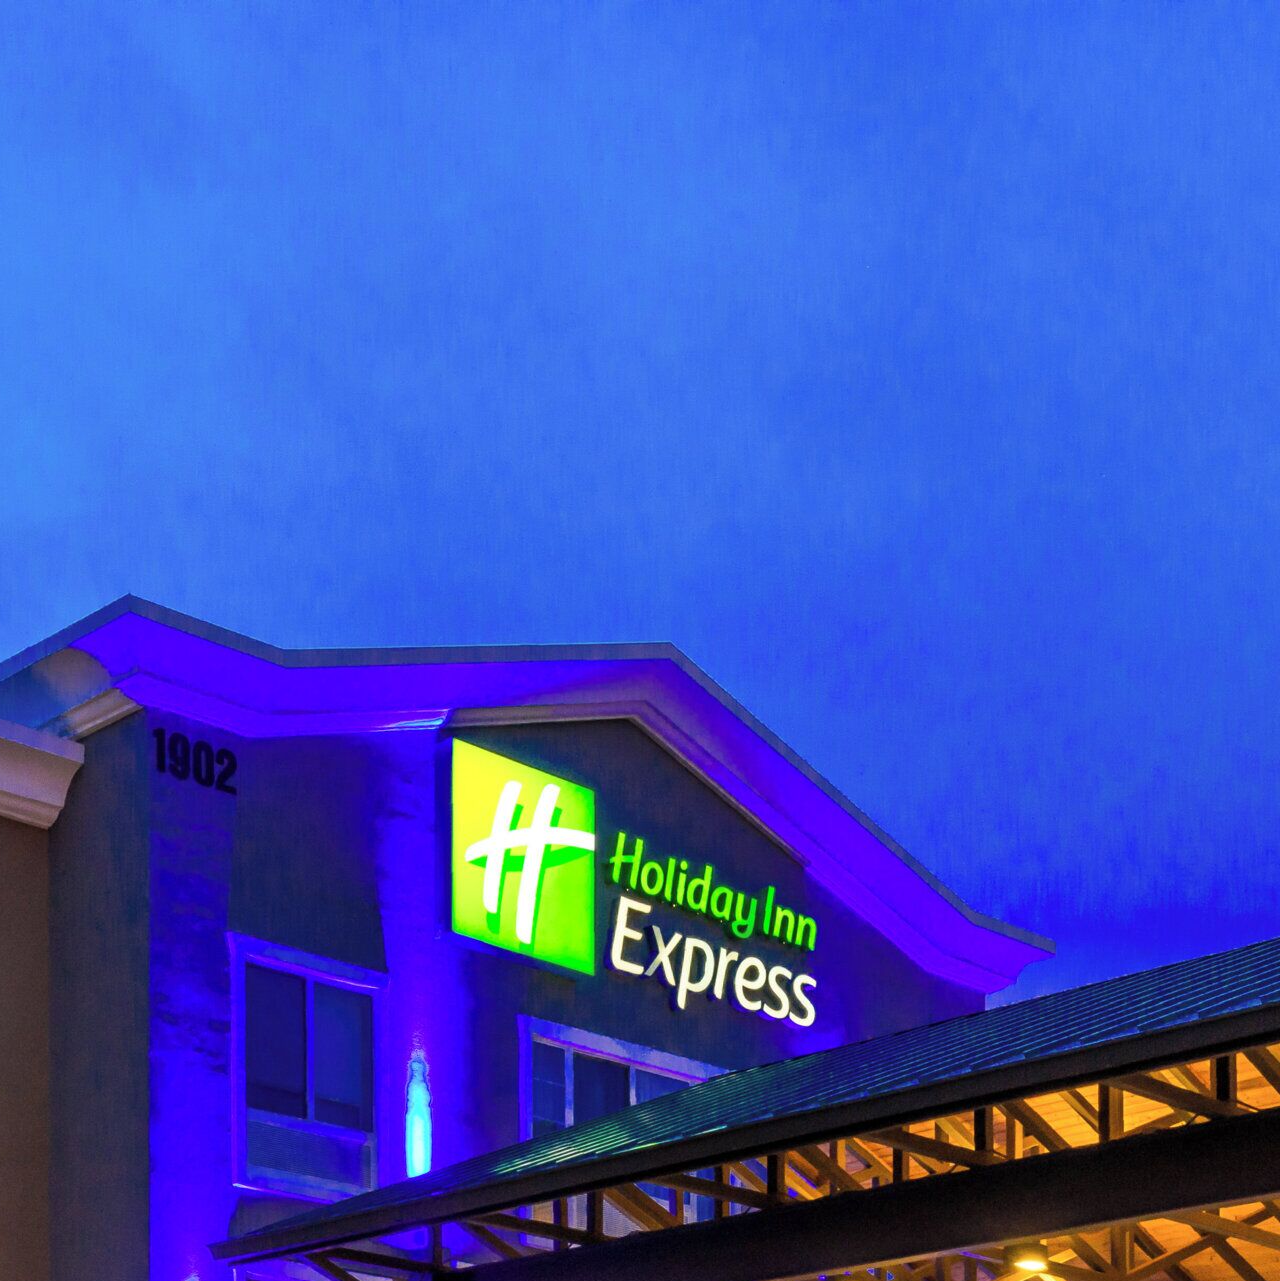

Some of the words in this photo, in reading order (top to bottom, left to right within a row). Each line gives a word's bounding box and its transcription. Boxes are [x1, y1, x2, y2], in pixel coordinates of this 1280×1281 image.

[152, 727, 238, 796] 1902
[609, 832, 758, 939] Holiday
[763, 886, 817, 951] Inn
[610, 895, 817, 1027] Express
